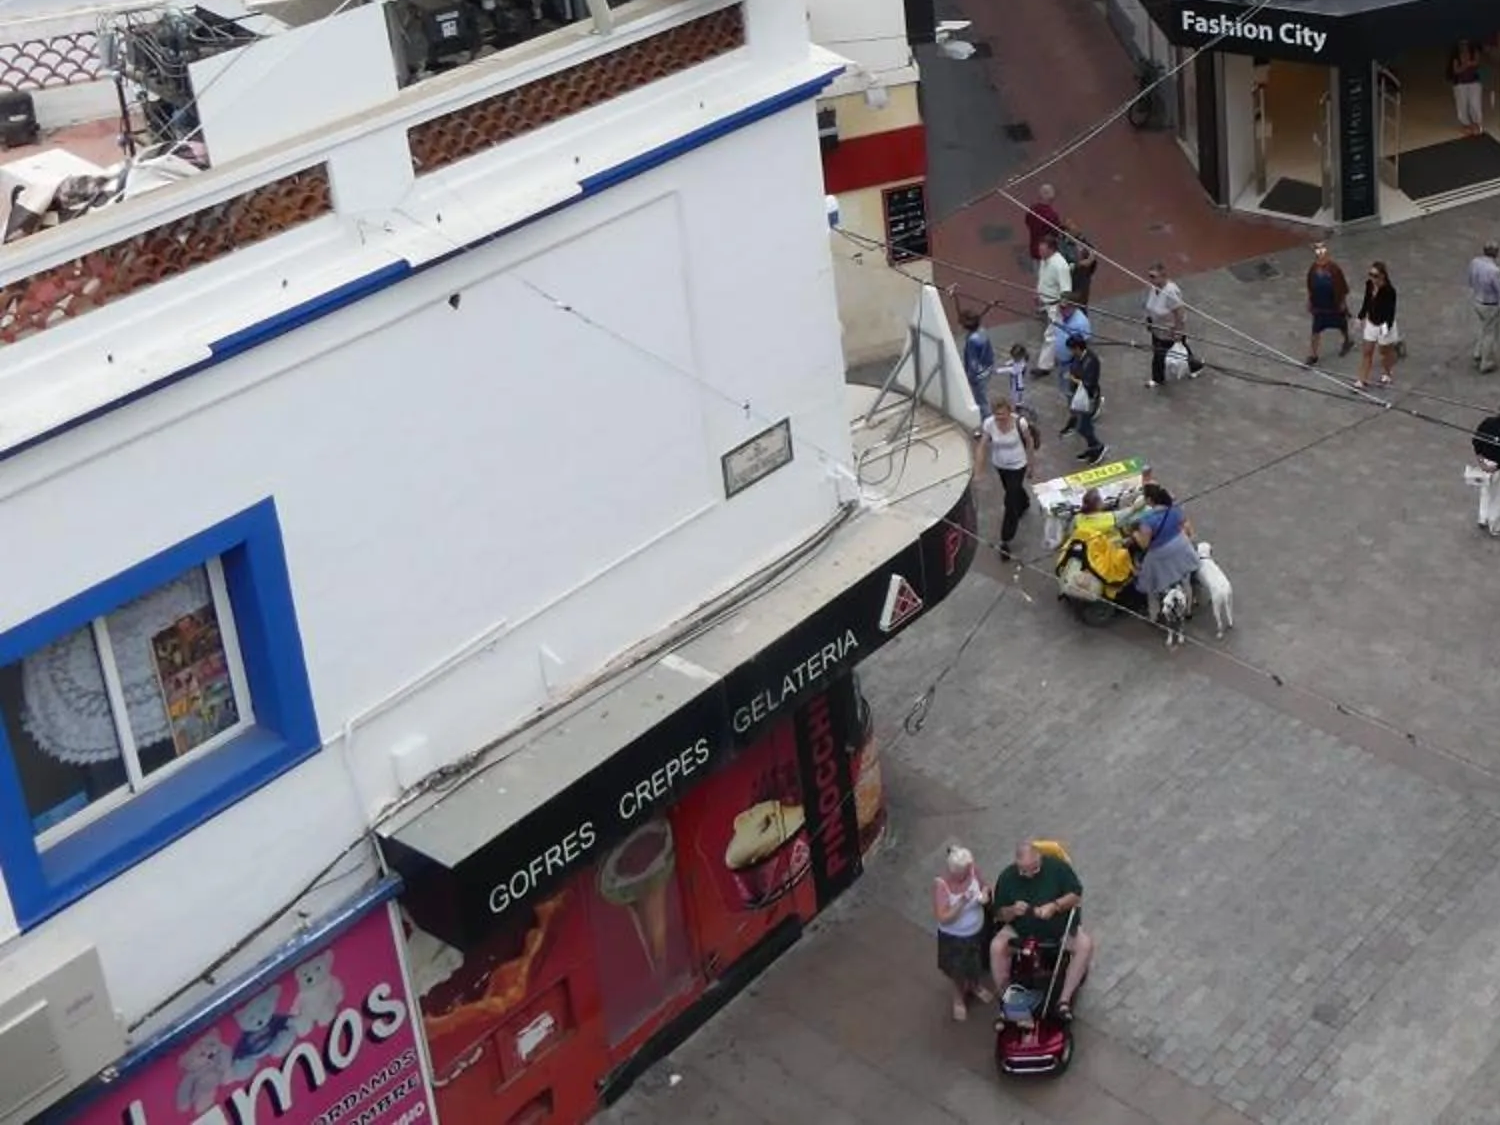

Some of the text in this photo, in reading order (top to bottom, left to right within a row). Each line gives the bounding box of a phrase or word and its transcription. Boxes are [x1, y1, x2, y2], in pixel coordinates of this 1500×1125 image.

[1181, 10, 1328, 53] Fashion City
[489, 627, 859, 914] GOFRES CREPES GELATERIA
